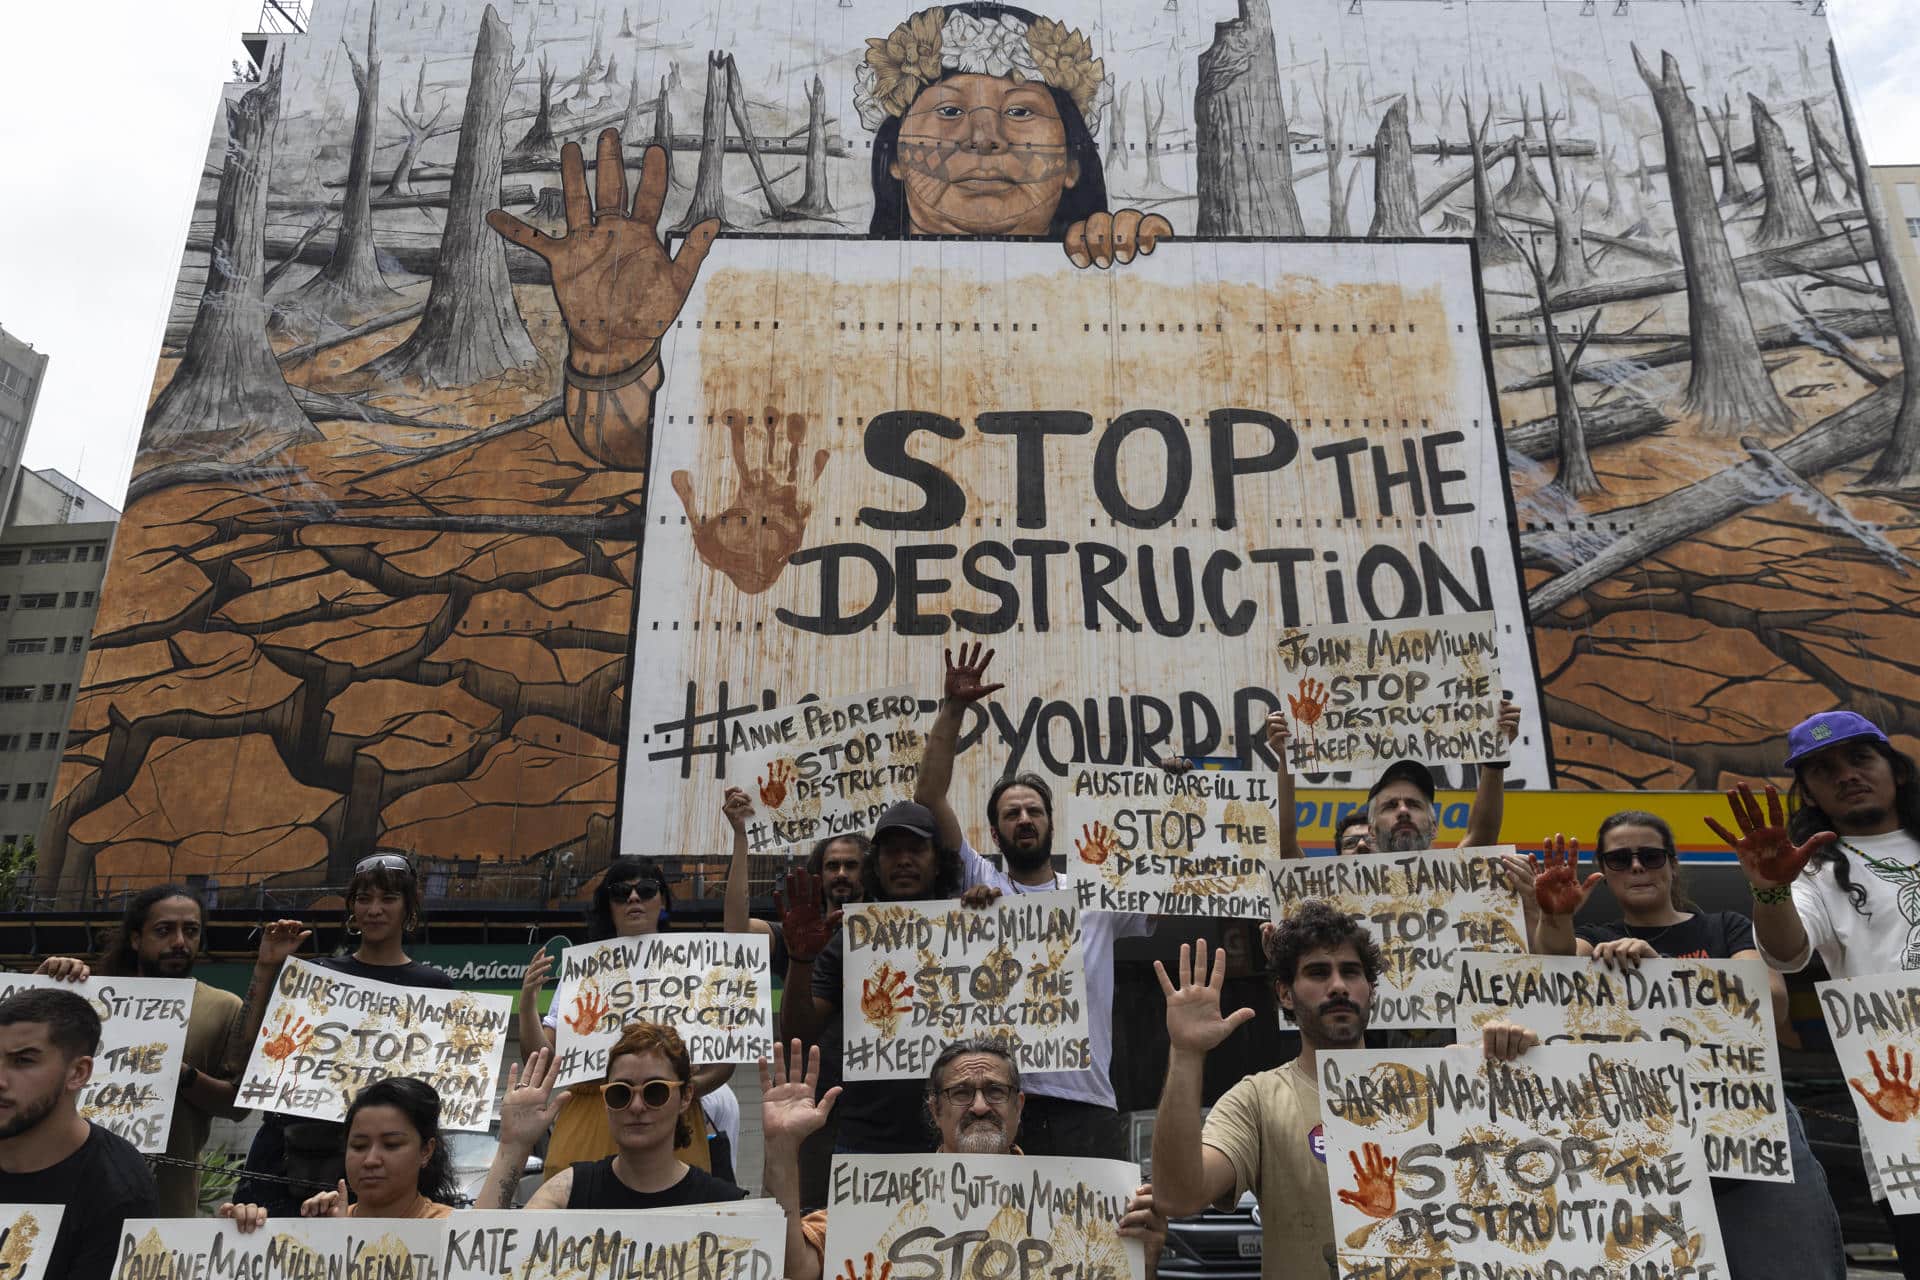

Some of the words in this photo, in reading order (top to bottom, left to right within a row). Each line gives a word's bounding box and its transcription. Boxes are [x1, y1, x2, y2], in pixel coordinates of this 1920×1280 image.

[859, 408, 1300, 532] STOP
[1312, 430, 1476, 519] THE
[1278, 633, 1350, 672] JOHN
[1330, 671, 1430, 706] STOP
[1436, 676, 1490, 699] THE
[731, 718, 799, 755] ANNE
[795, 733, 881, 779] STOP
[889, 725, 917, 750] THE
[1286, 737, 1360, 770] #KEEP
[1363, 732, 1420, 760] YOUR
[1076, 770, 1158, 797] AUSTEN
[749, 814, 820, 852] #KEEP
[1114, 810, 1205, 851] STOP
[1215, 823, 1268, 845] THE
[1074, 878, 1151, 912] #KEEP
[1451, 920, 1507, 944] THE
[563, 941, 643, 982] ANDREW
[913, 959, 1022, 1000] STOP
[1027, 967, 1073, 996] THE
[610, 975, 701, 1008] STOP
[708, 979, 757, 999] THE
[1457, 960, 1616, 1008] ALEXANDRA
[104, 1046, 168, 1074] THE
[311, 1021, 433, 1064] STOP
[434, 1041, 488, 1066] THE
[560, 1047, 606, 1079] #KE
[846, 1034, 938, 1073] #KEEP
[1700, 1043, 1766, 1073] THE
[240, 1074, 334, 1113] #KEEP
[1322, 1057, 1422, 1121] SARAH
[1398, 1137, 1600, 1200] STOP
[1604, 1151, 1692, 1199] THE
[951, 1162, 1024, 1221] SUTTON
[443, 1227, 518, 1280] KATE
[696, 1231, 772, 1280] REED
[888, 1226, 1051, 1280] STOP
